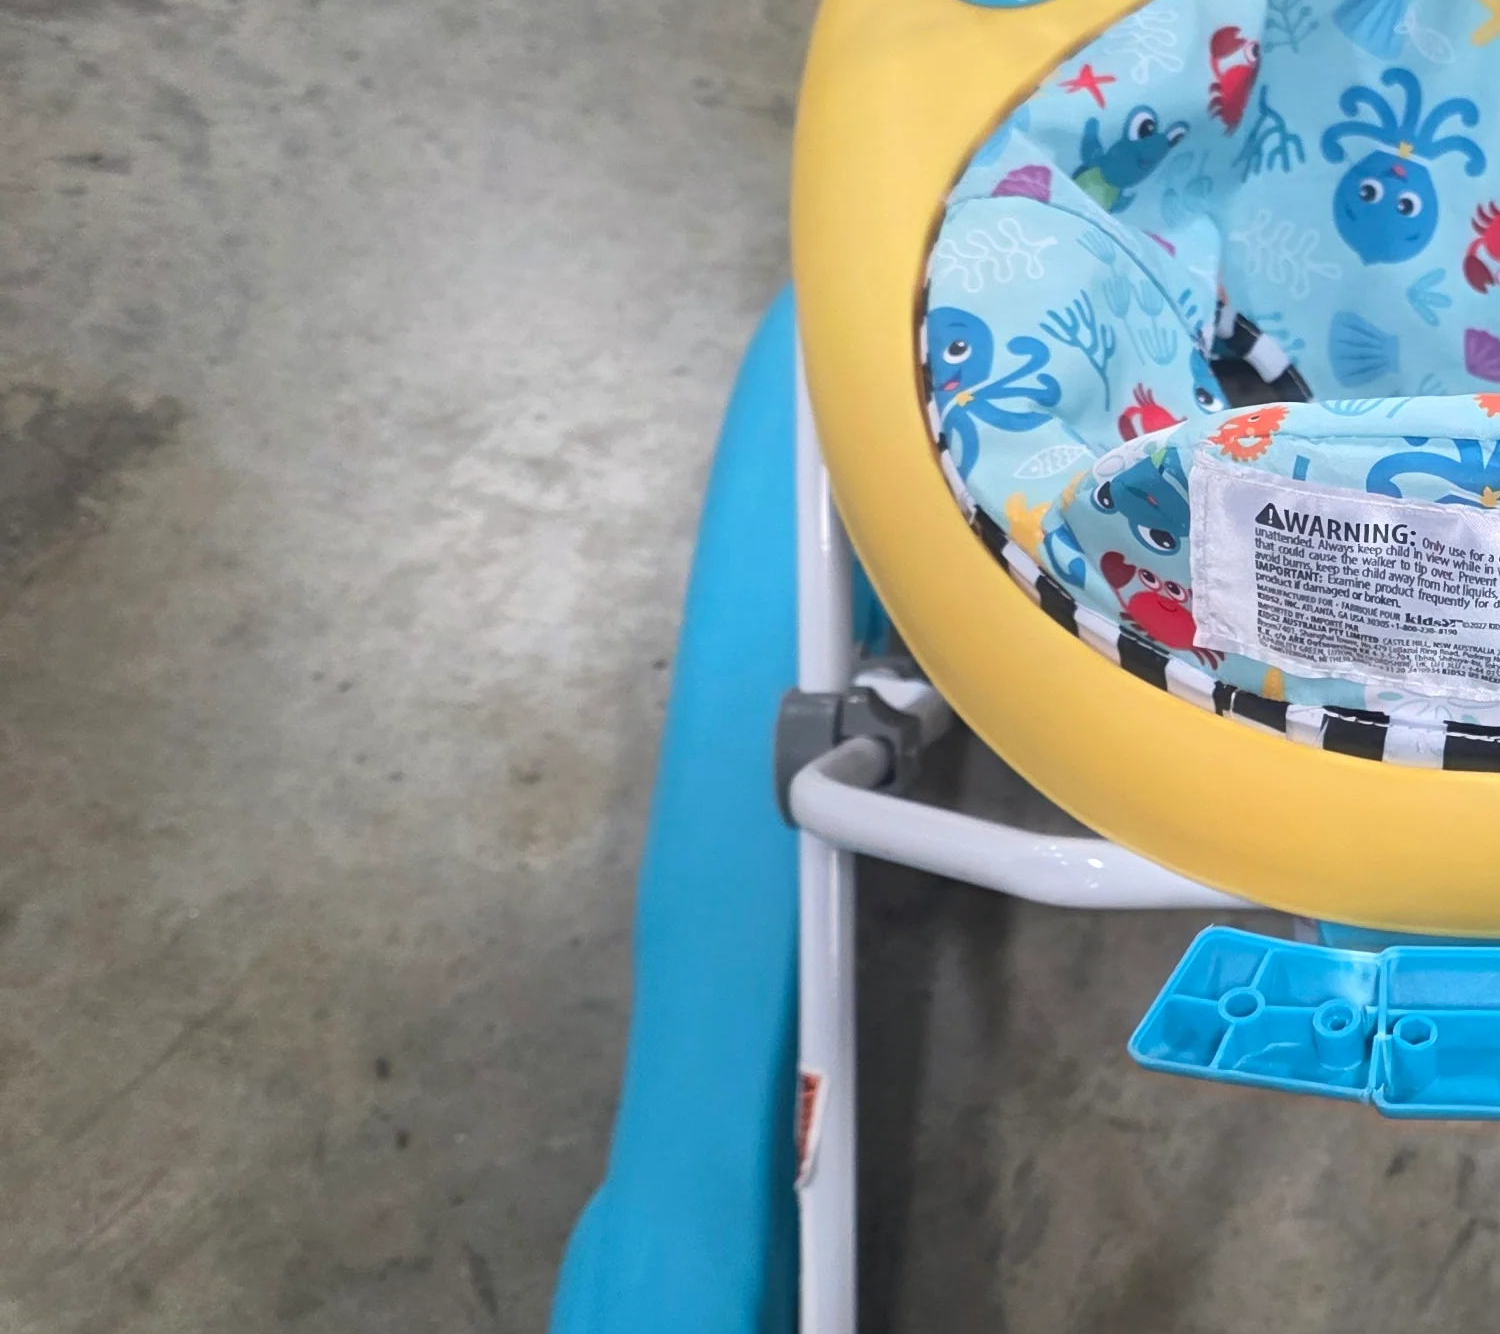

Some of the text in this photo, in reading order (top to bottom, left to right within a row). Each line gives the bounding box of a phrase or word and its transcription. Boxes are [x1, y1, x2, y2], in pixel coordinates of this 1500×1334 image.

[1255, 527, 1314, 549] unattended.
[1318, 539, 1354, 554] Always
[1358, 544, 1382, 557] keep
[1386, 545, 1410, 557] child
[1413, 547, 1423, 560] in
[1426, 552, 1450, 566] view
[1453, 559, 1481, 572] while
[1485, 563, 1494, 574] in
[1284, 509, 1416, 547] WARNING:
[1422, 537, 1445, 555] Only
[1449, 547, 1466, 558] use
[1470, 549, 1485, 561] for
[1488, 554, 1494, 562] a
[1255, 537, 1274, 551] that
[1278, 546, 1305, 558] could
[1309, 552, 1337, 562] cause
[1341, 552, 1358, 565] the
[1362, 556, 1396, 569] walker
[1401, 559, 1410, 571] to
[1415, 561, 1427, 576] tip
[1431, 568, 1454, 581] over.
[1459, 571, 1498, 586] Prevent
[1255, 551, 1280, 564] avoid
[1316, 561, 1340, 576] keep
[1343, 566, 1359, 576] the
[1362, 567, 1386, 580] child
[1388, 572, 1415, 587] away
[1417, 574, 1440, 591] from
[1443, 581, 1460, 595] hot
[1463, 584, 1498, 600] liquids,
[1255, 560, 1323, 583] IMPORTANT:
[1328, 573, 1371, 590] Examine
[1375, 583, 1414, 598] product
[1418, 588, 1470, 610] frequently
[1475, 598, 1489, 608] for
[1255, 572, 1291, 589] product
[1303, 582, 1350, 598] damaged
[1352, 592, 1363, 600] or
[1364, 591, 1401, 608] broken.
[1318, 597, 1333, 607] FOR
[1380, 610, 1401, 621] POUR
[1338, 611, 1348, 619] GA
[1350, 613, 1365, 624] USA
[1345, 623, 1359, 632] PAR
[1282, 617, 1327, 632] AUSTRALIA
[1329, 627, 1344, 636] PTY
[1346, 631, 1379, 643] LIMITED
[1383, 638, 1410, 647] CASTLE
[1453, 644, 1495, 655] AUSTRALIA
